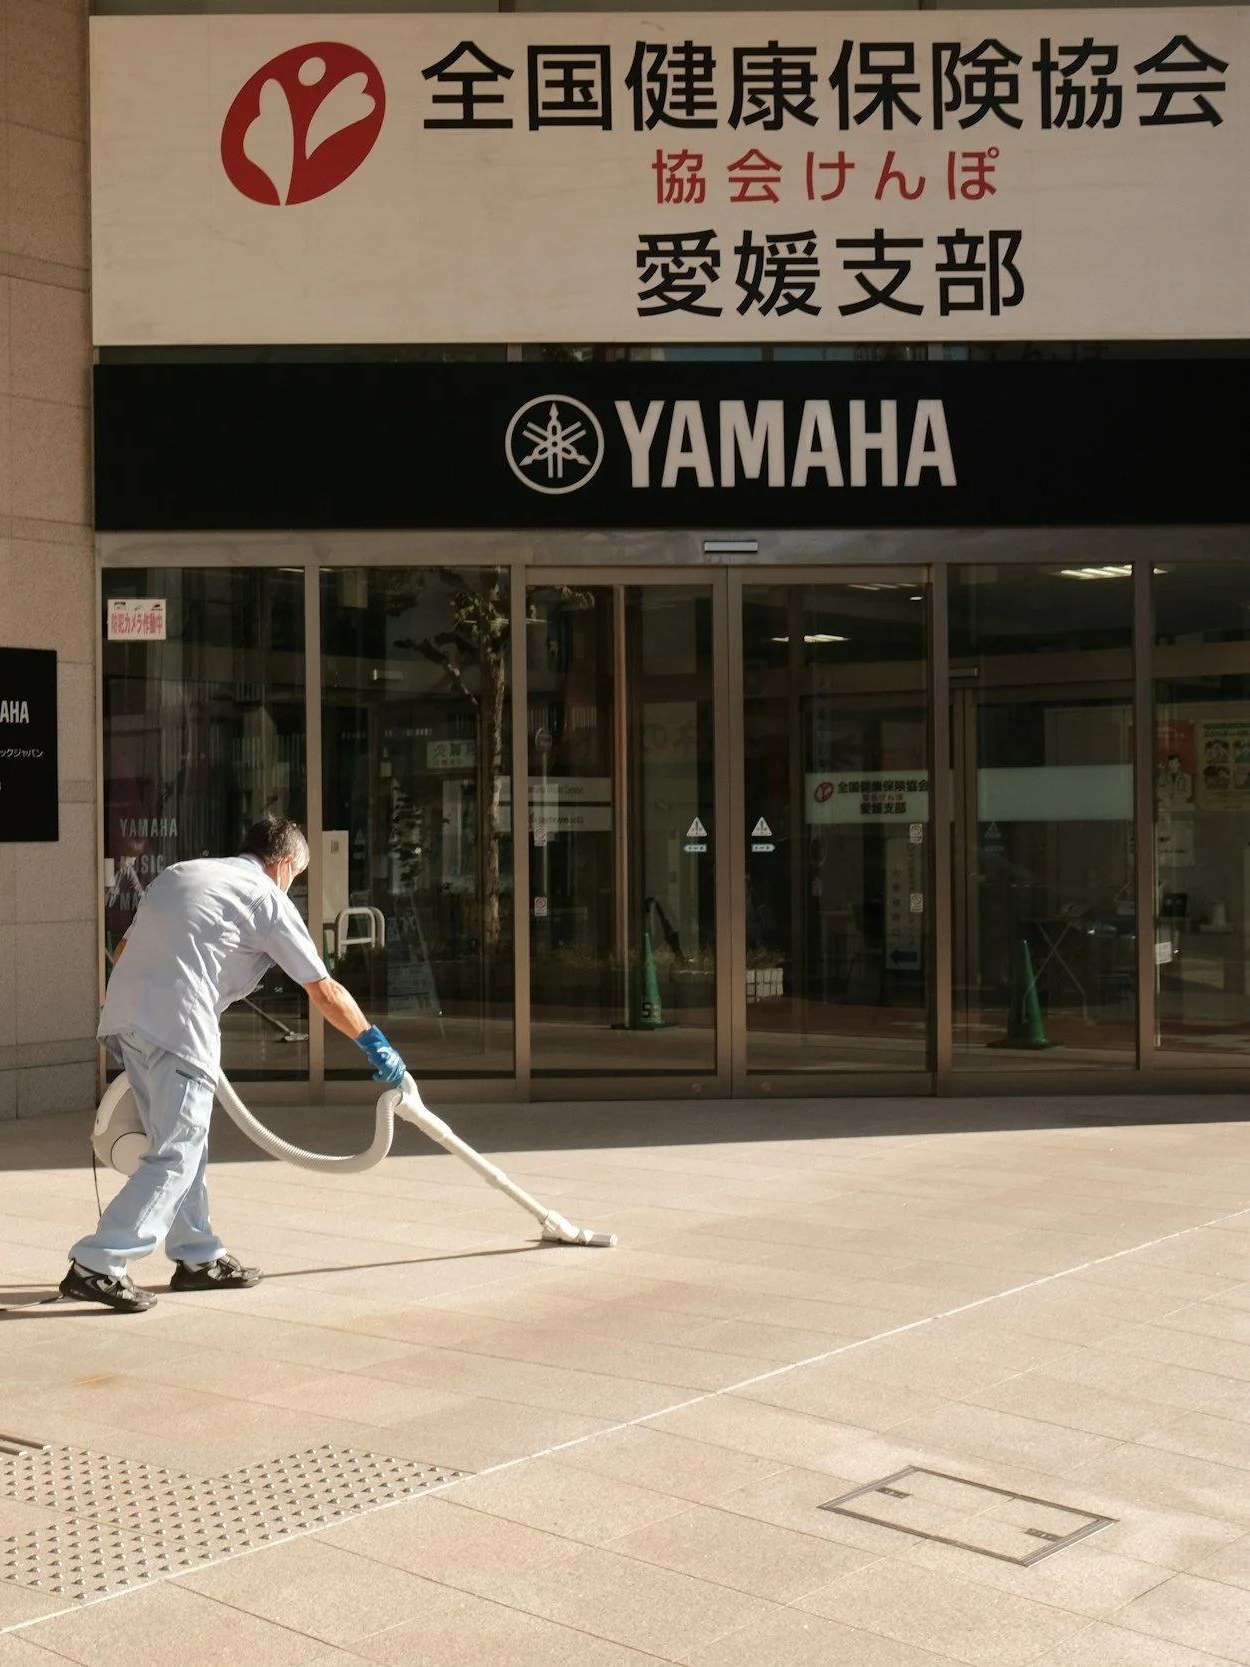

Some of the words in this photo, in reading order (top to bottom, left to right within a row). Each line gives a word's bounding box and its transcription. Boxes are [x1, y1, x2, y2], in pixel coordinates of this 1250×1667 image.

[420, 34, 1230, 131] 全国健康保険協会
[651, 146, 1000, 204] 協会けんぽ
[635, 228, 1026, 318] 愛媛支部
[614, 398, 958, 489] YAMAHA
[119, 818, 178, 838] YAMAHA
